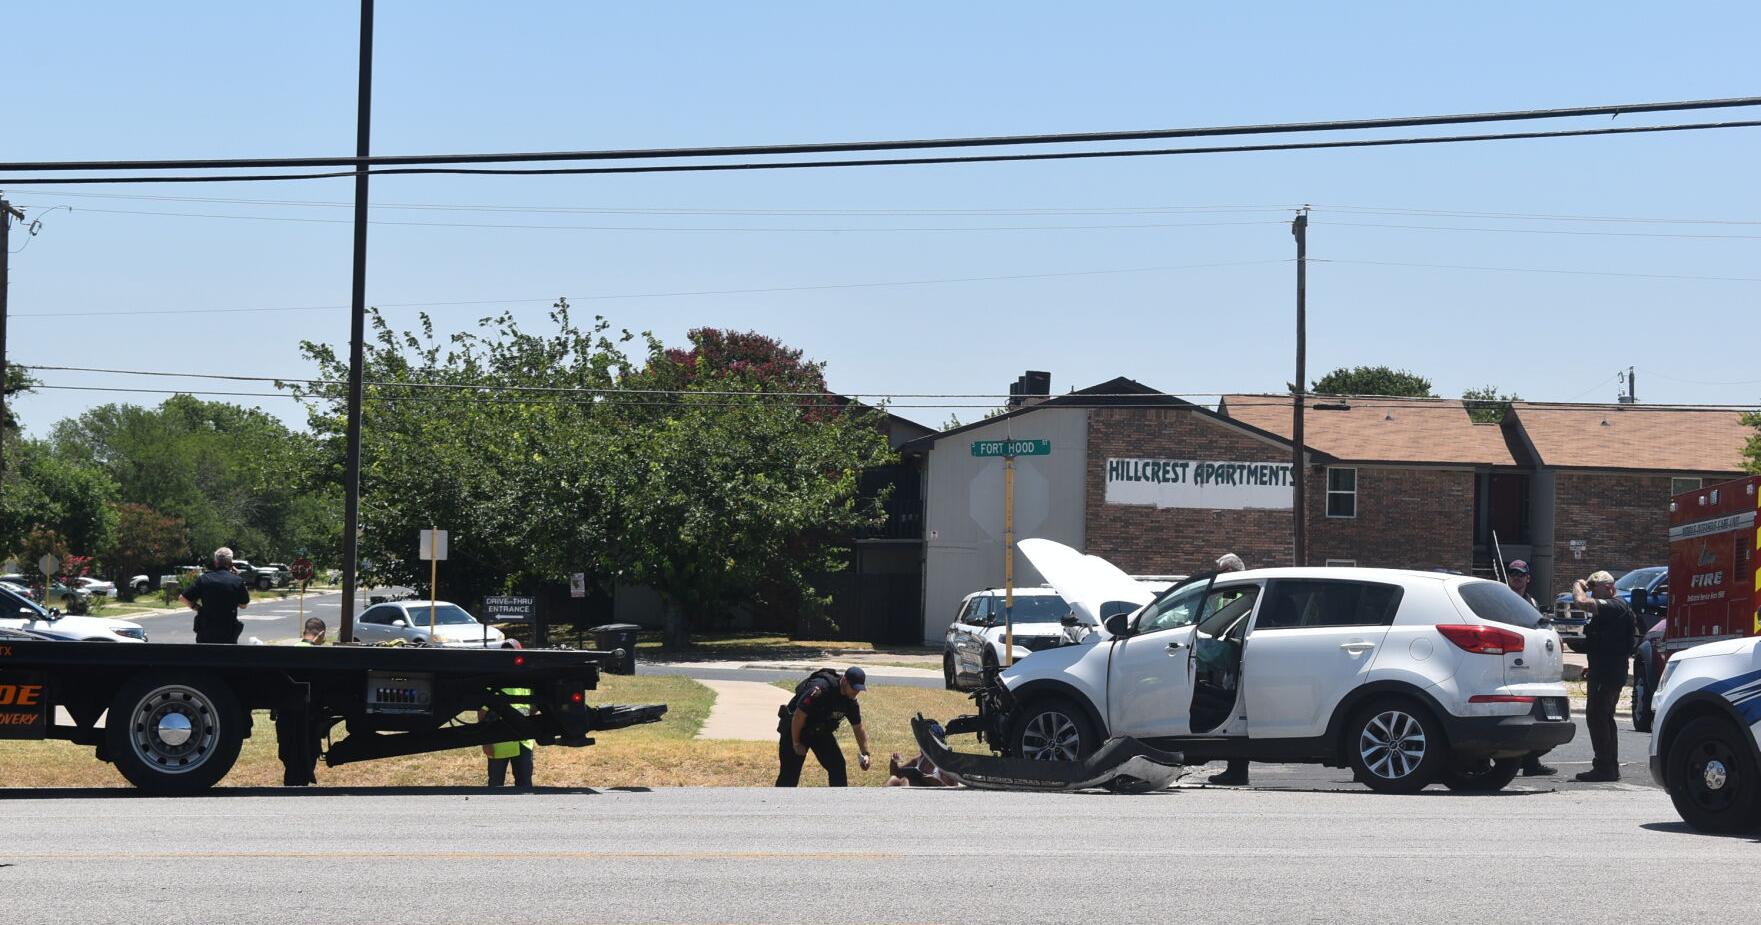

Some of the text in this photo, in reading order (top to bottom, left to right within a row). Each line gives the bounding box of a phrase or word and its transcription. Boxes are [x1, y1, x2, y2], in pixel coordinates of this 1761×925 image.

[980, 443, 1003, 455] FORT
[1008, 441, 1034, 454] HOOD
[1109, 460, 1189, 485] HILLCREST
[1691, 571, 1722, 588] FIRE
[488, 605, 530, 613] ENTRANCE
